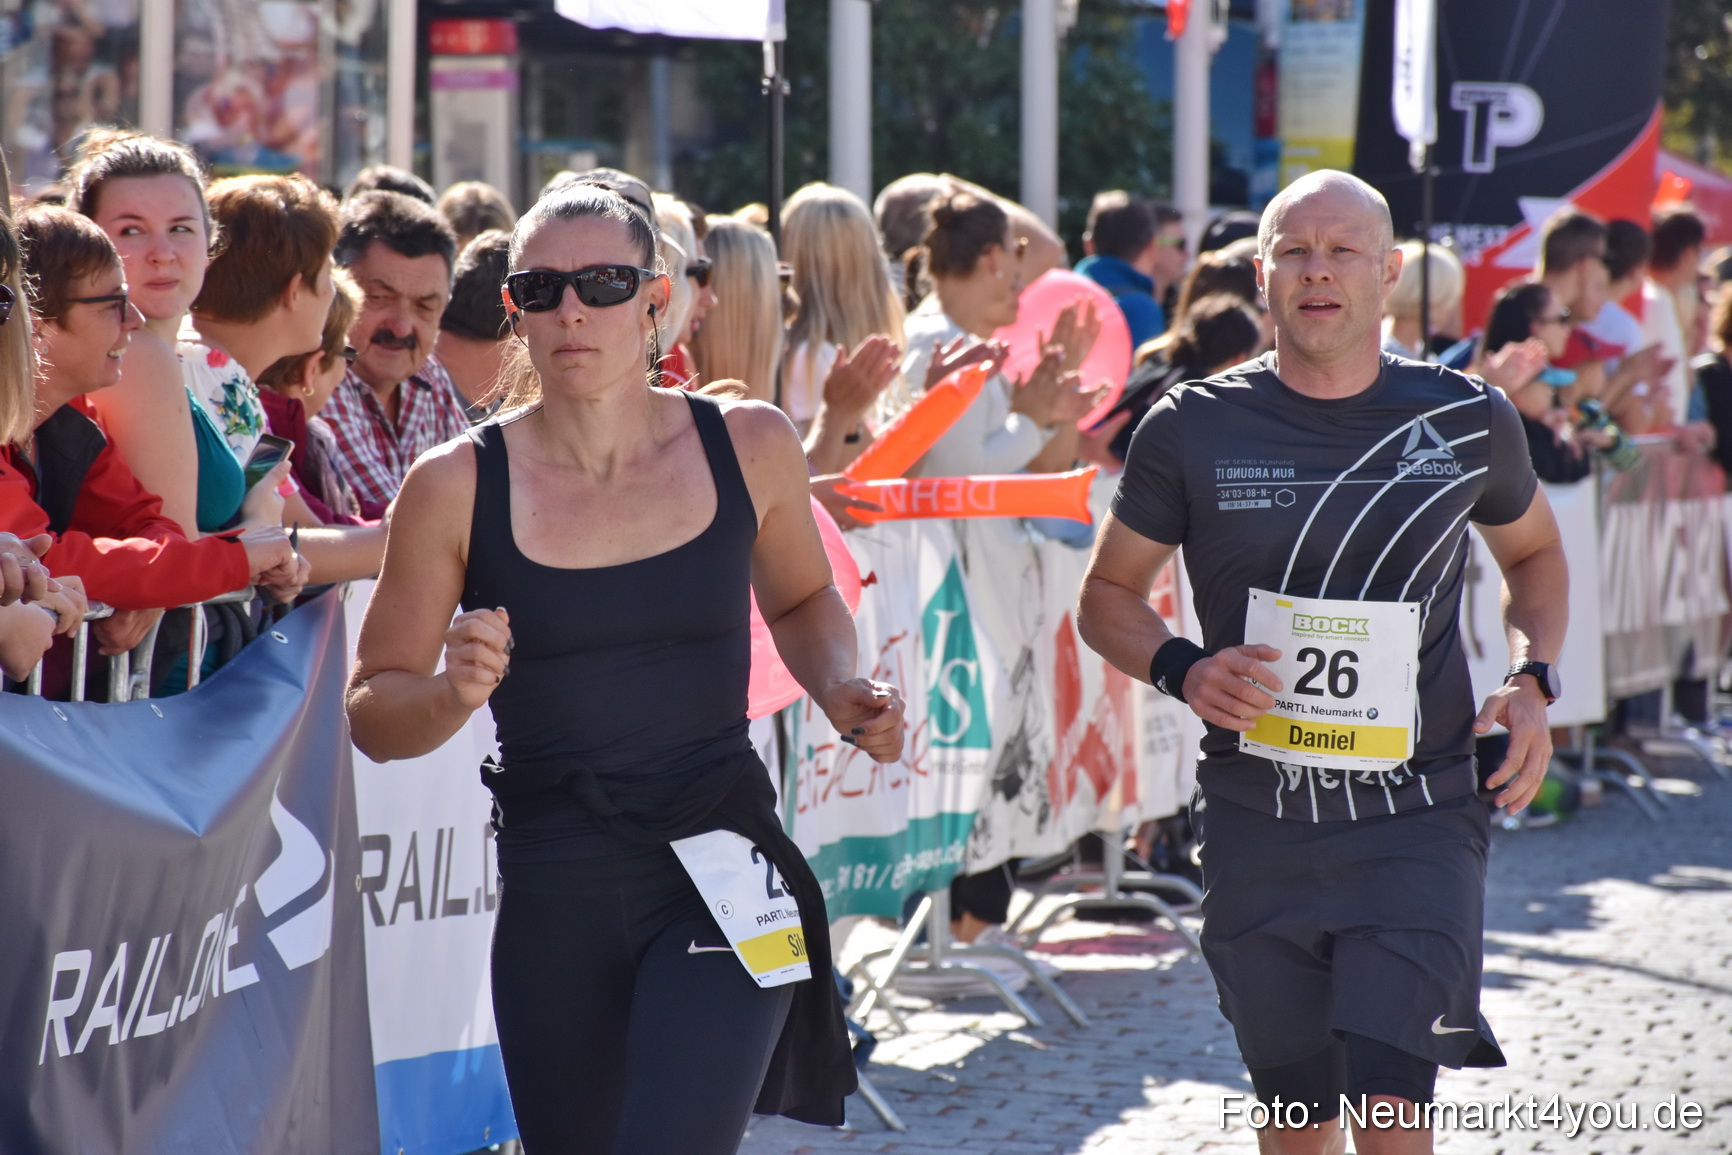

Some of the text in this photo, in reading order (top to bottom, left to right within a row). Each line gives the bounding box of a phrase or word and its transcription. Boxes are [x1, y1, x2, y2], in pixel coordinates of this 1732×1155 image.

[1397, 461, 1464, 476] Reebok
[879, 481, 997, 513] DEHN
[1291, 631, 1315, 639] inspired
[1292, 613, 1370, 636] BOCK
[1293, 647, 1359, 699] 26
[1274, 699, 1363, 718] PARTL Neumarkt
[1289, 725, 1356, 751] Daniel
[756, 909, 786, 927] PARTL
[38, 883, 261, 1066] RAIL.ONE
